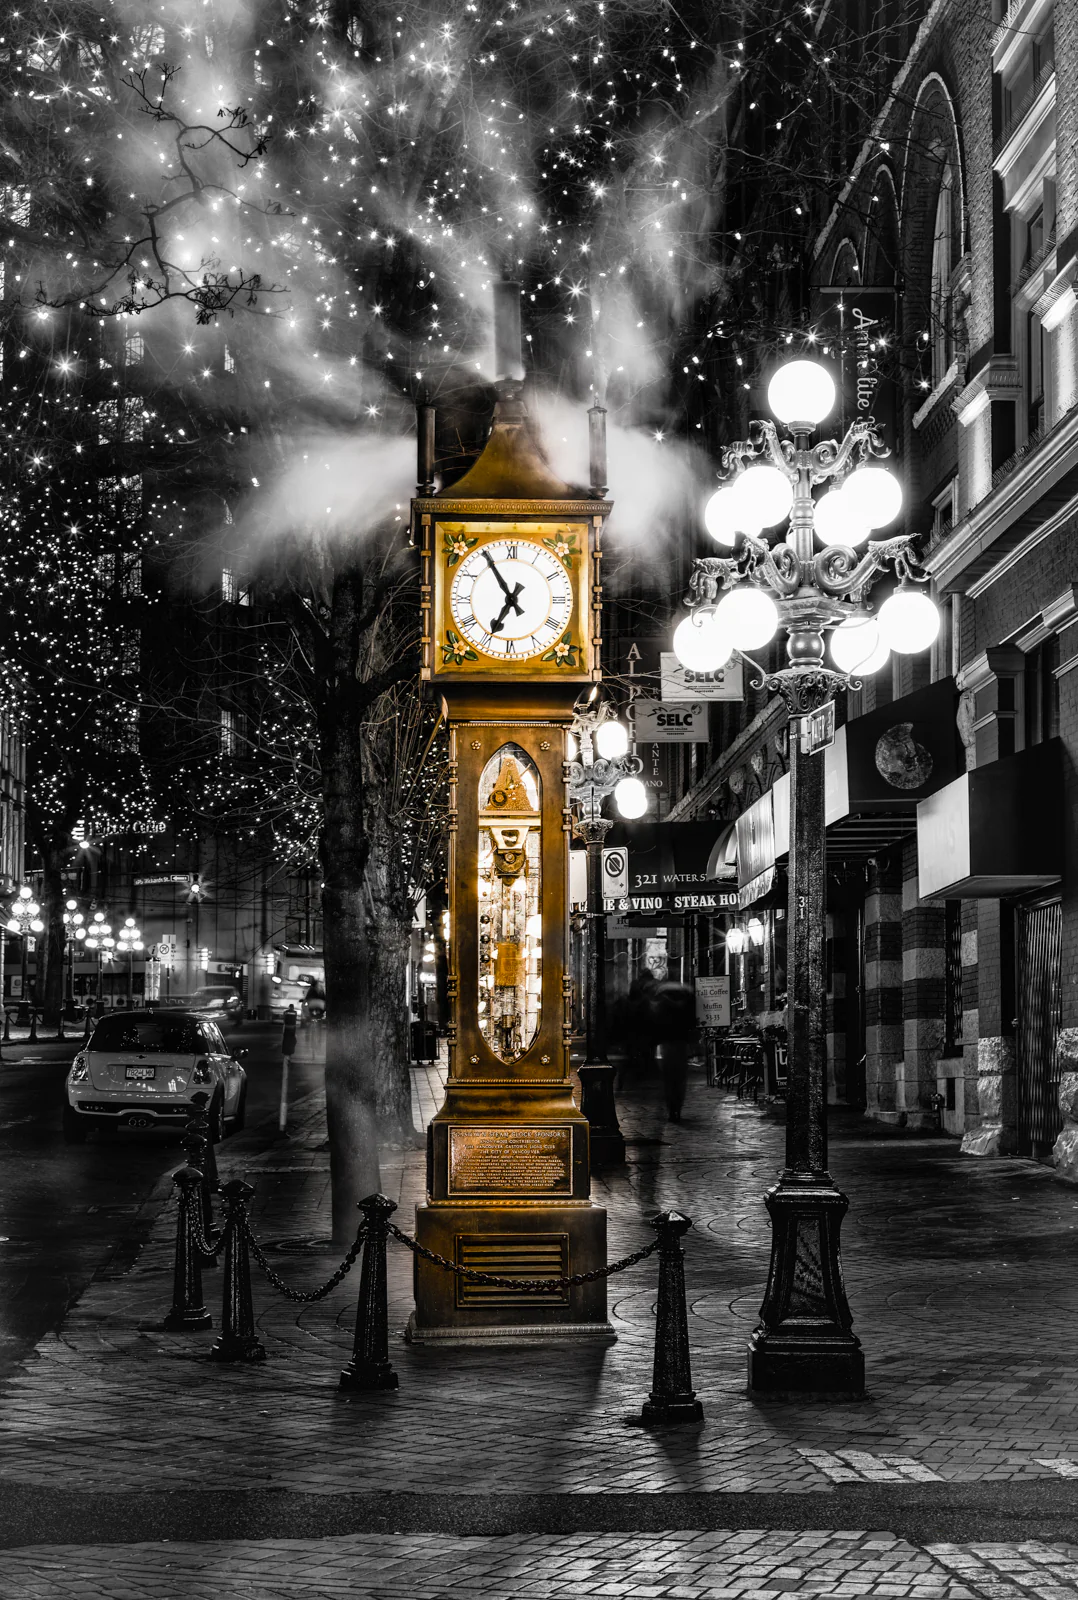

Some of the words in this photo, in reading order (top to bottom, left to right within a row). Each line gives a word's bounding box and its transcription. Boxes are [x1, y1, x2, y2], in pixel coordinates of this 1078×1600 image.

[684, 668, 725, 683] SELC
[656, 714, 693, 728] SELC
[634, 874, 658, 888] 321
[663, 873, 700, 883] WATER
[619, 898, 630, 910] &
[632, 896, 663, 910] VINO
[674, 894, 717, 909] STEAK
[709, 988, 728, 996] Coffee
